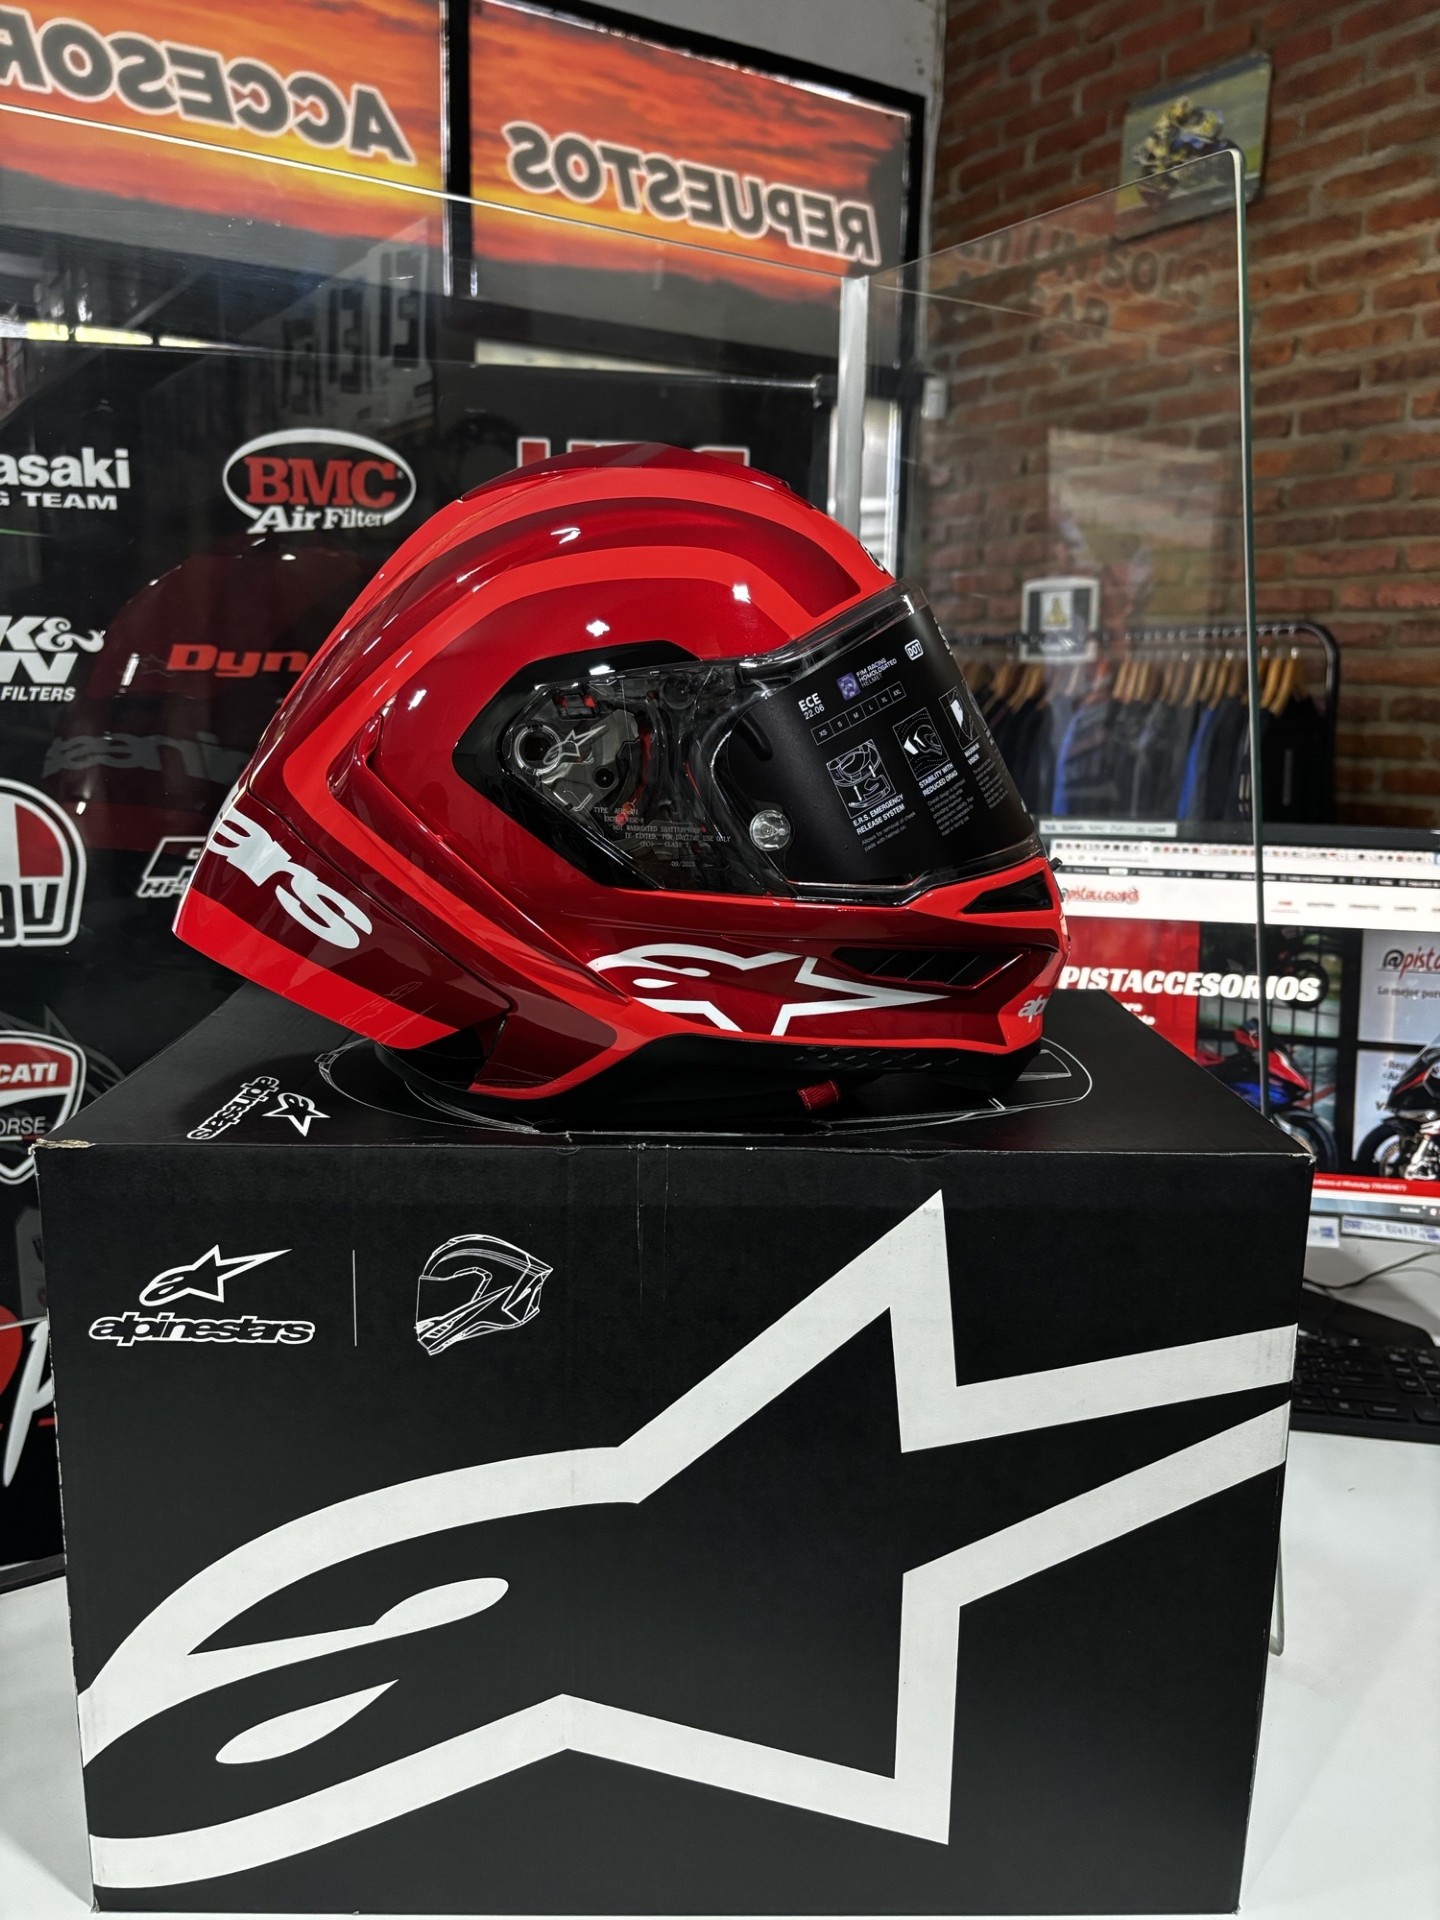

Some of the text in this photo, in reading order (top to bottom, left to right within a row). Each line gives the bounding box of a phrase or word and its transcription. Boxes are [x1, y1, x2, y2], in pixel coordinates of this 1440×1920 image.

[243, 456, 397, 509] BMC
[21, 491, 118, 511] TEAM
[246, 504, 386, 535] Air Filter
[906, 642, 923, 658] DOT
[856, 668, 867, 677] FIM
[0, 685, 77, 702] FILTERS
[798, 693, 821, 712] ECE
[804, 704, 825, 720] 22.06
[919, 770, 942, 788] STABILITY
[922, 778, 946, 796] REDUCED
[853, 794, 903, 827] E.R.S. EMERGENCY
[856, 803, 905, 835] RELEASE SYSTEM
[1058, 966, 1321, 1002] PISTACCESORIOS
[88, 1311, 316, 1347] alpinestars
